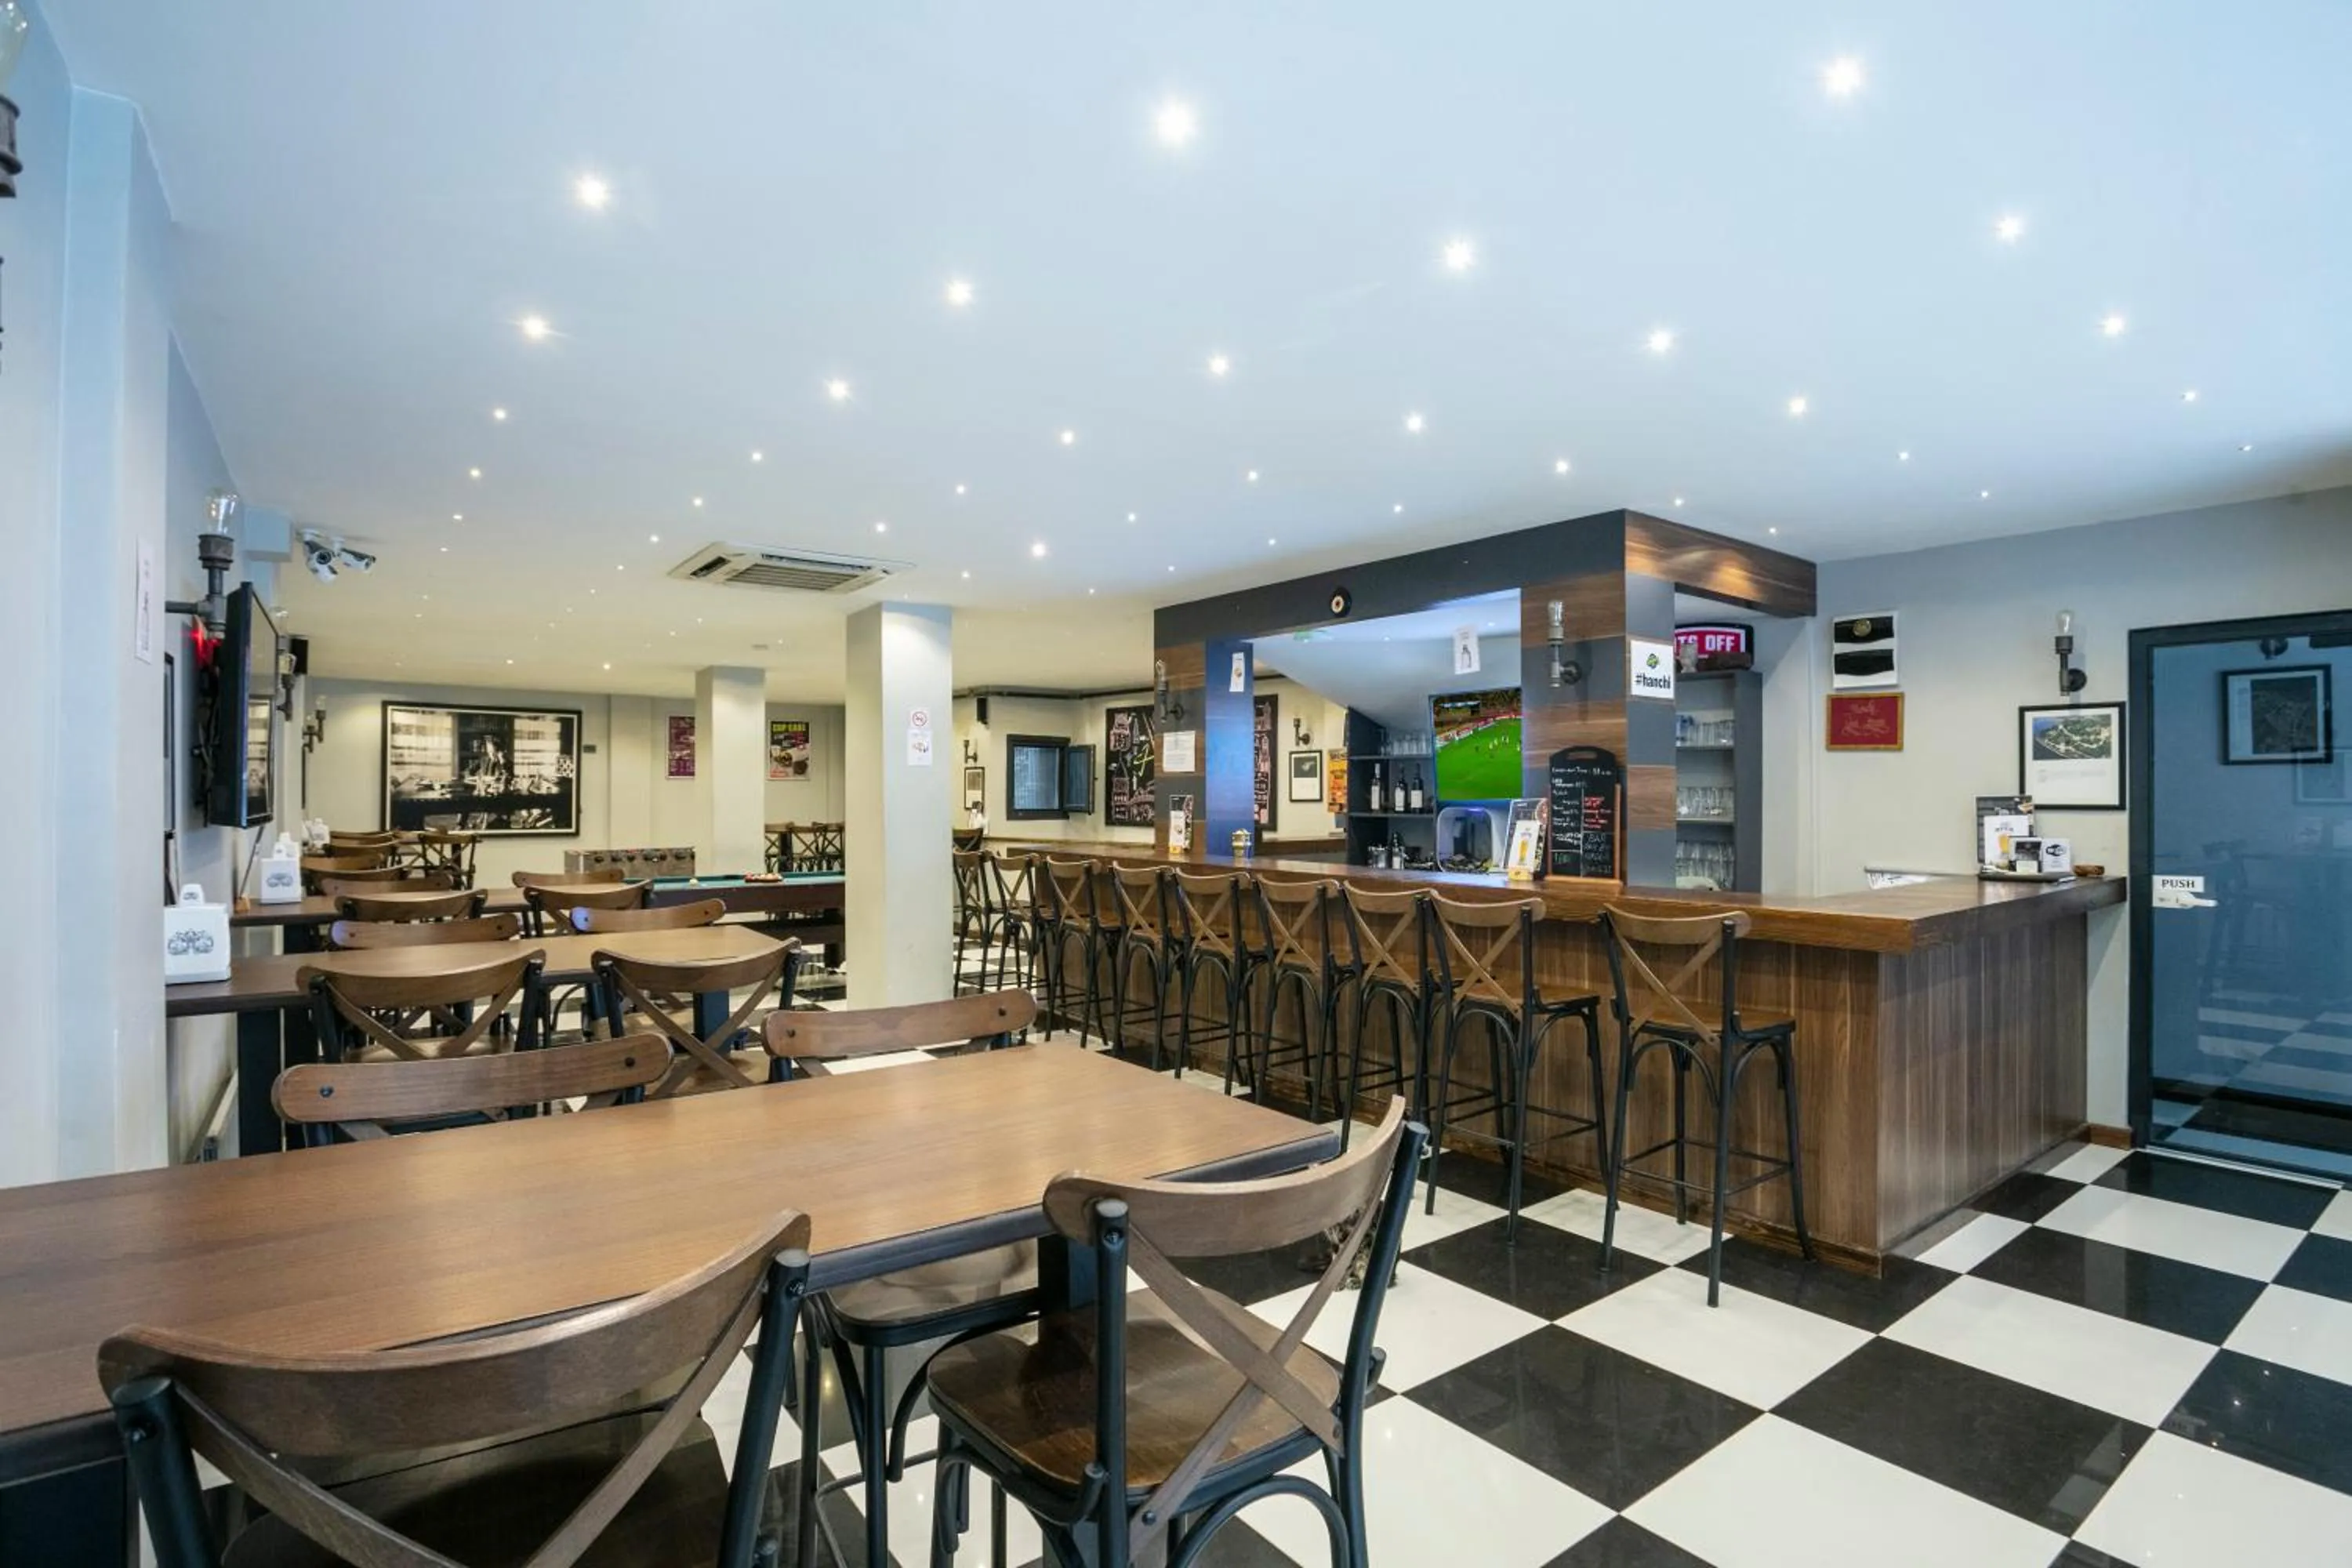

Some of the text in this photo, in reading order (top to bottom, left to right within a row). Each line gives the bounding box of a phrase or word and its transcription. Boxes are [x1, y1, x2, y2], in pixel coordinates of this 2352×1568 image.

[1705, 634, 1734, 652] OFF
[1635, 672, 1671, 689] #hanchi
[2161, 879, 2194, 888] PUSH
